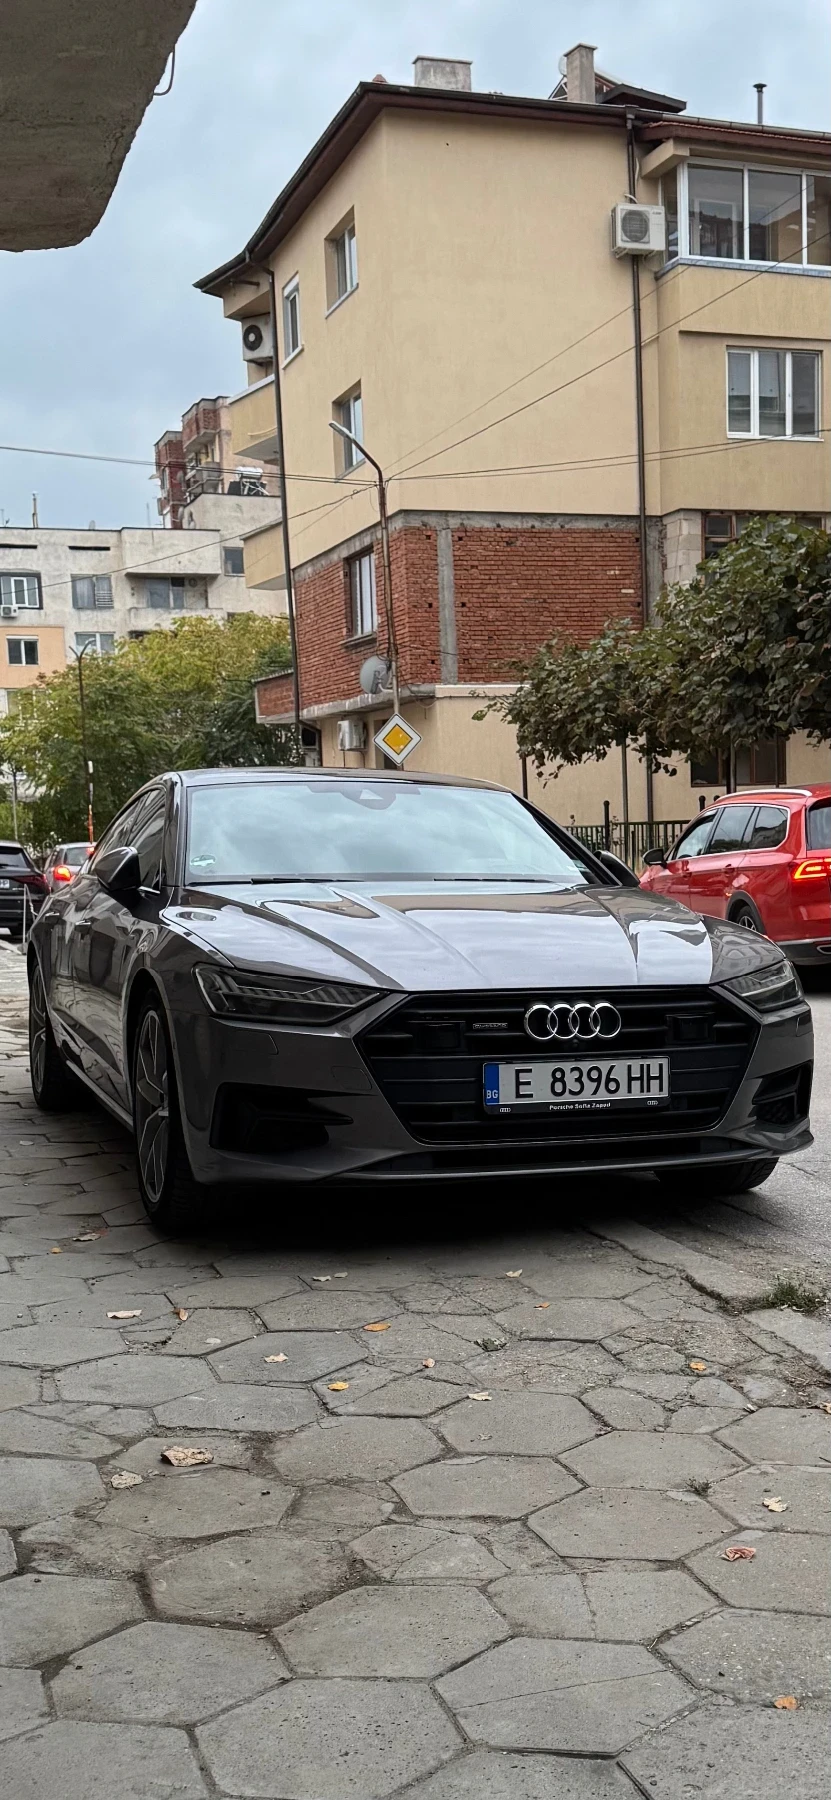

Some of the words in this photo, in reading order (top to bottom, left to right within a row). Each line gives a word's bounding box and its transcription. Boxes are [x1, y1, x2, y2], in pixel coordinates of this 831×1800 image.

[514, 1068, 534, 1099] E
[550, 1065, 620, 1097] 8396
[627, 1062, 664, 1094] HH
[486, 1089, 499, 1099] BG
